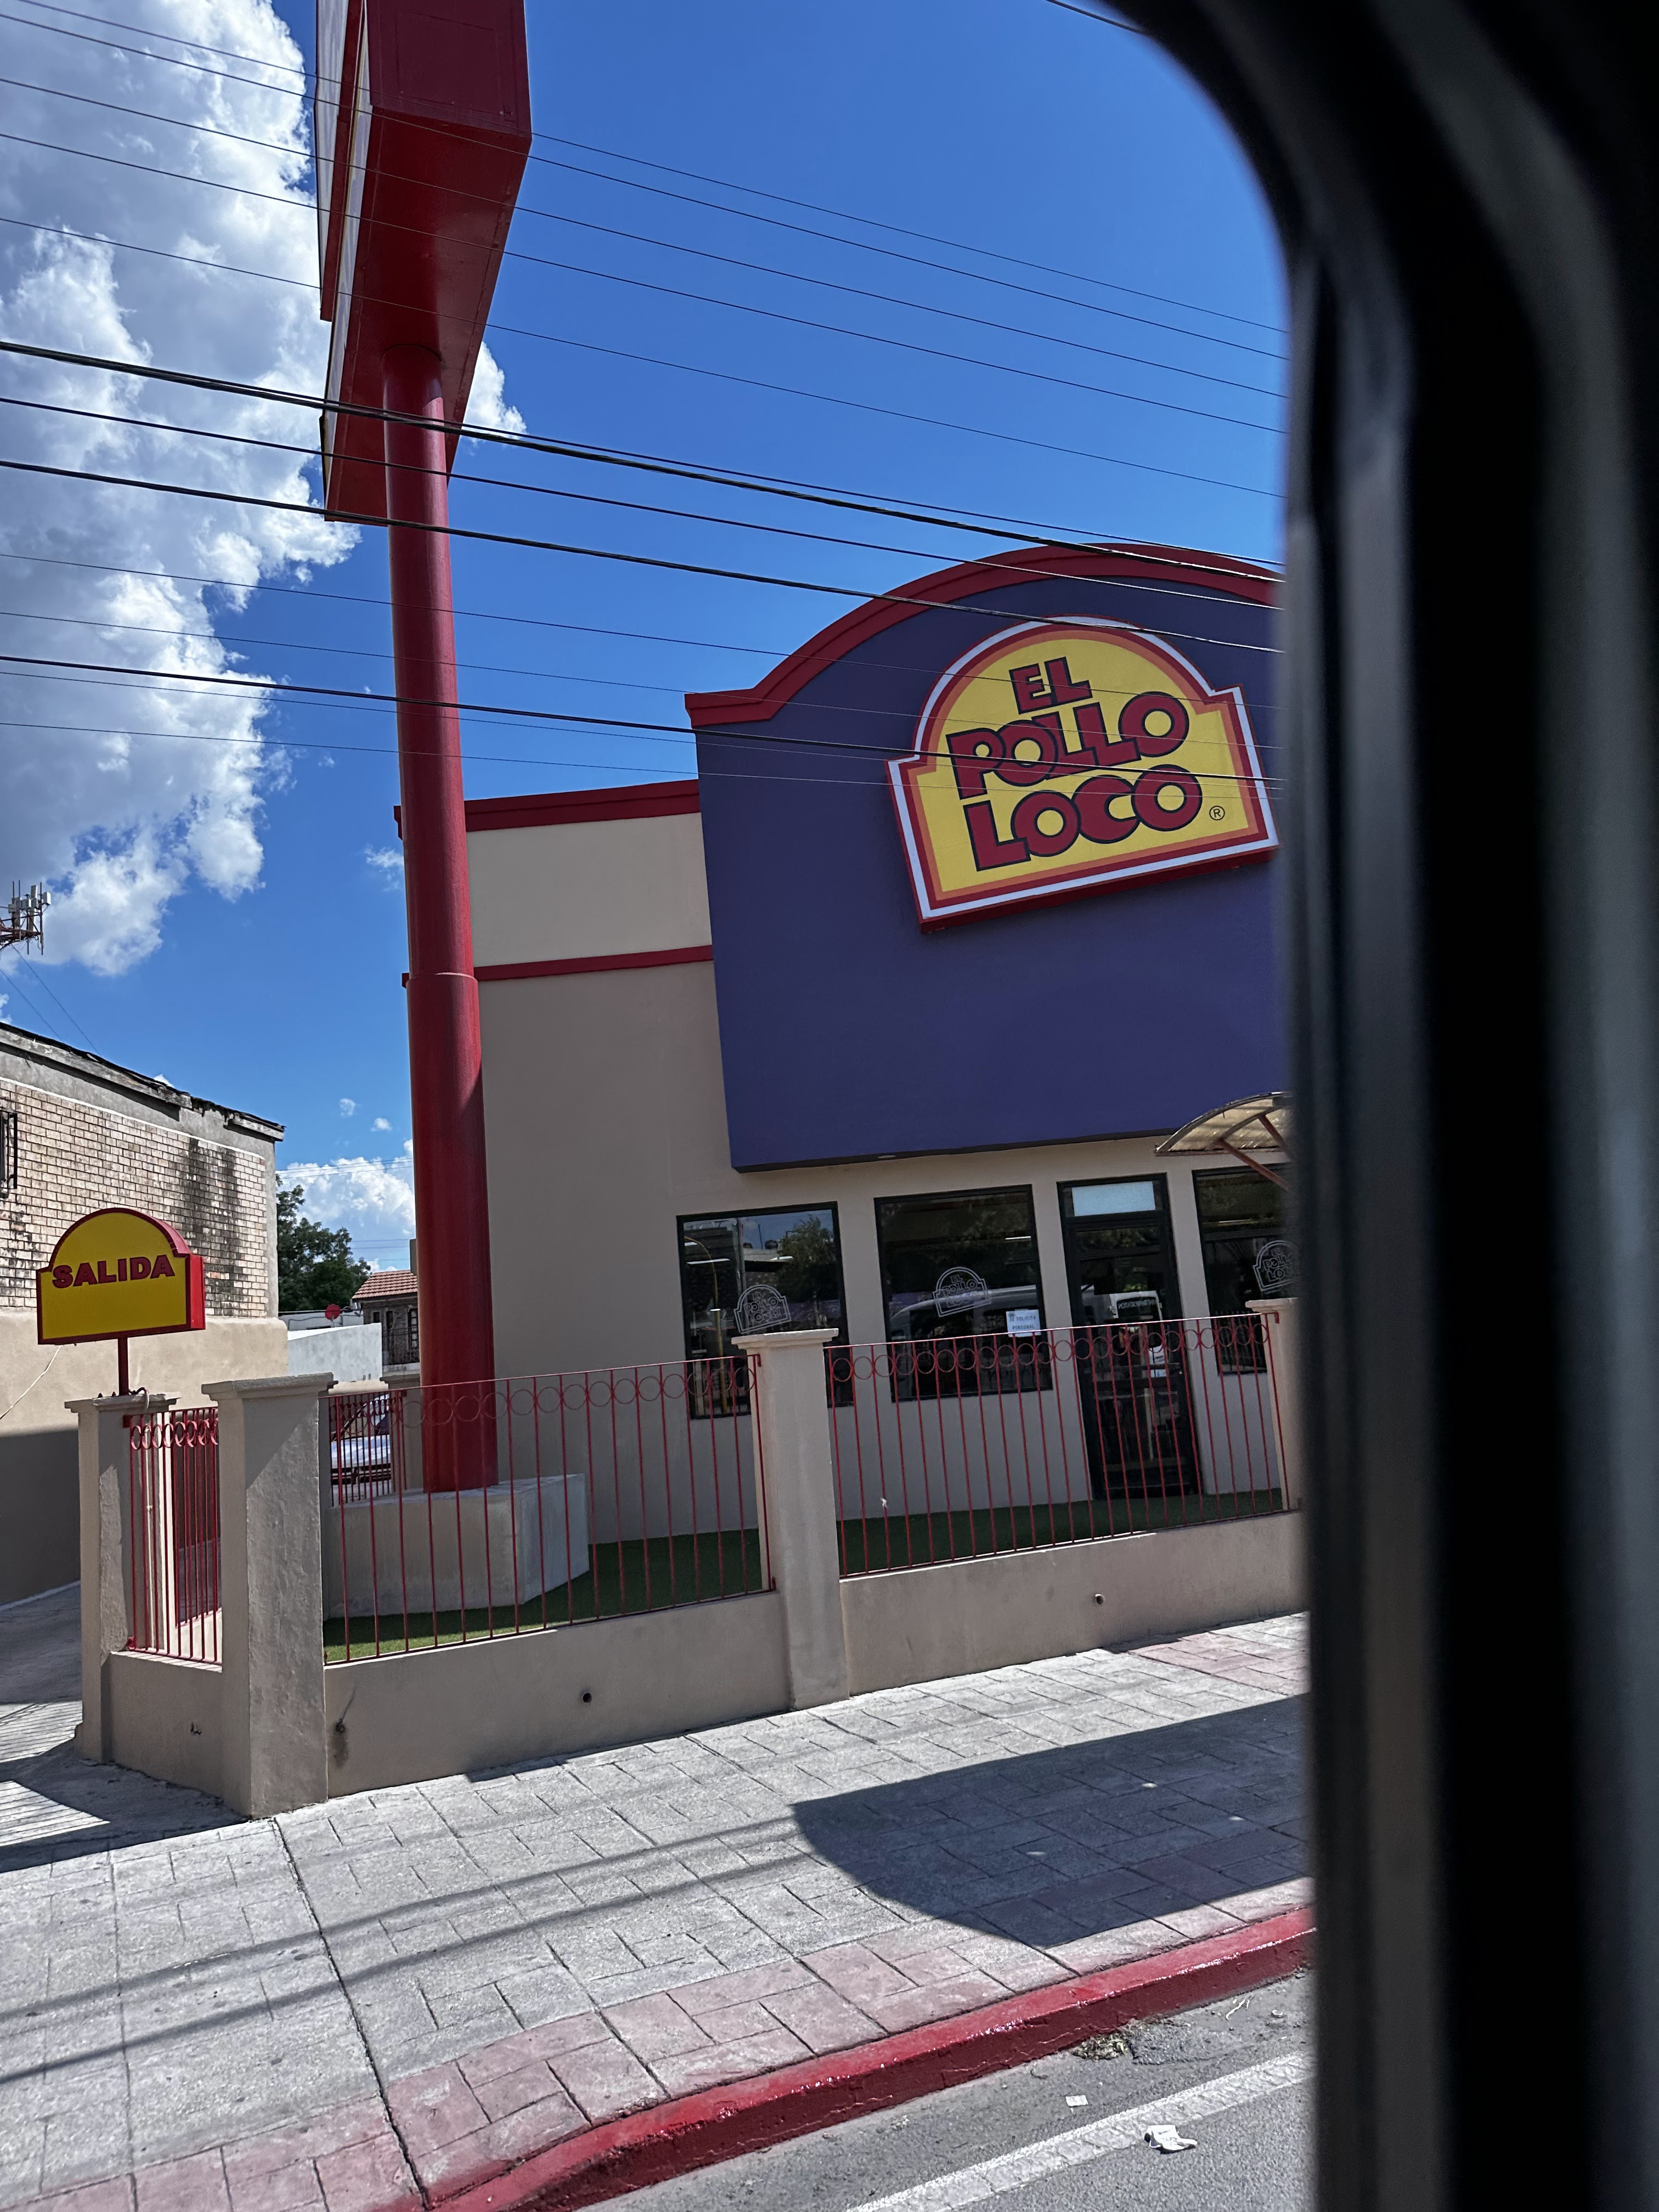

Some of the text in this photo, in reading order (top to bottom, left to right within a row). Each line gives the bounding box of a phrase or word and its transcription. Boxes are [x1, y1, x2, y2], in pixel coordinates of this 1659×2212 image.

[1009, 657, 1092, 714] EL
[946, 691, 1189, 800] POLLO
[963, 764, 1202, 871] LOCO
[52, 1254, 175, 1289] SALIDA
[942, 1279, 977, 1296] POLLO
[950, 1274, 963, 1283] EL
[743, 1296, 778, 1314] POLLO
